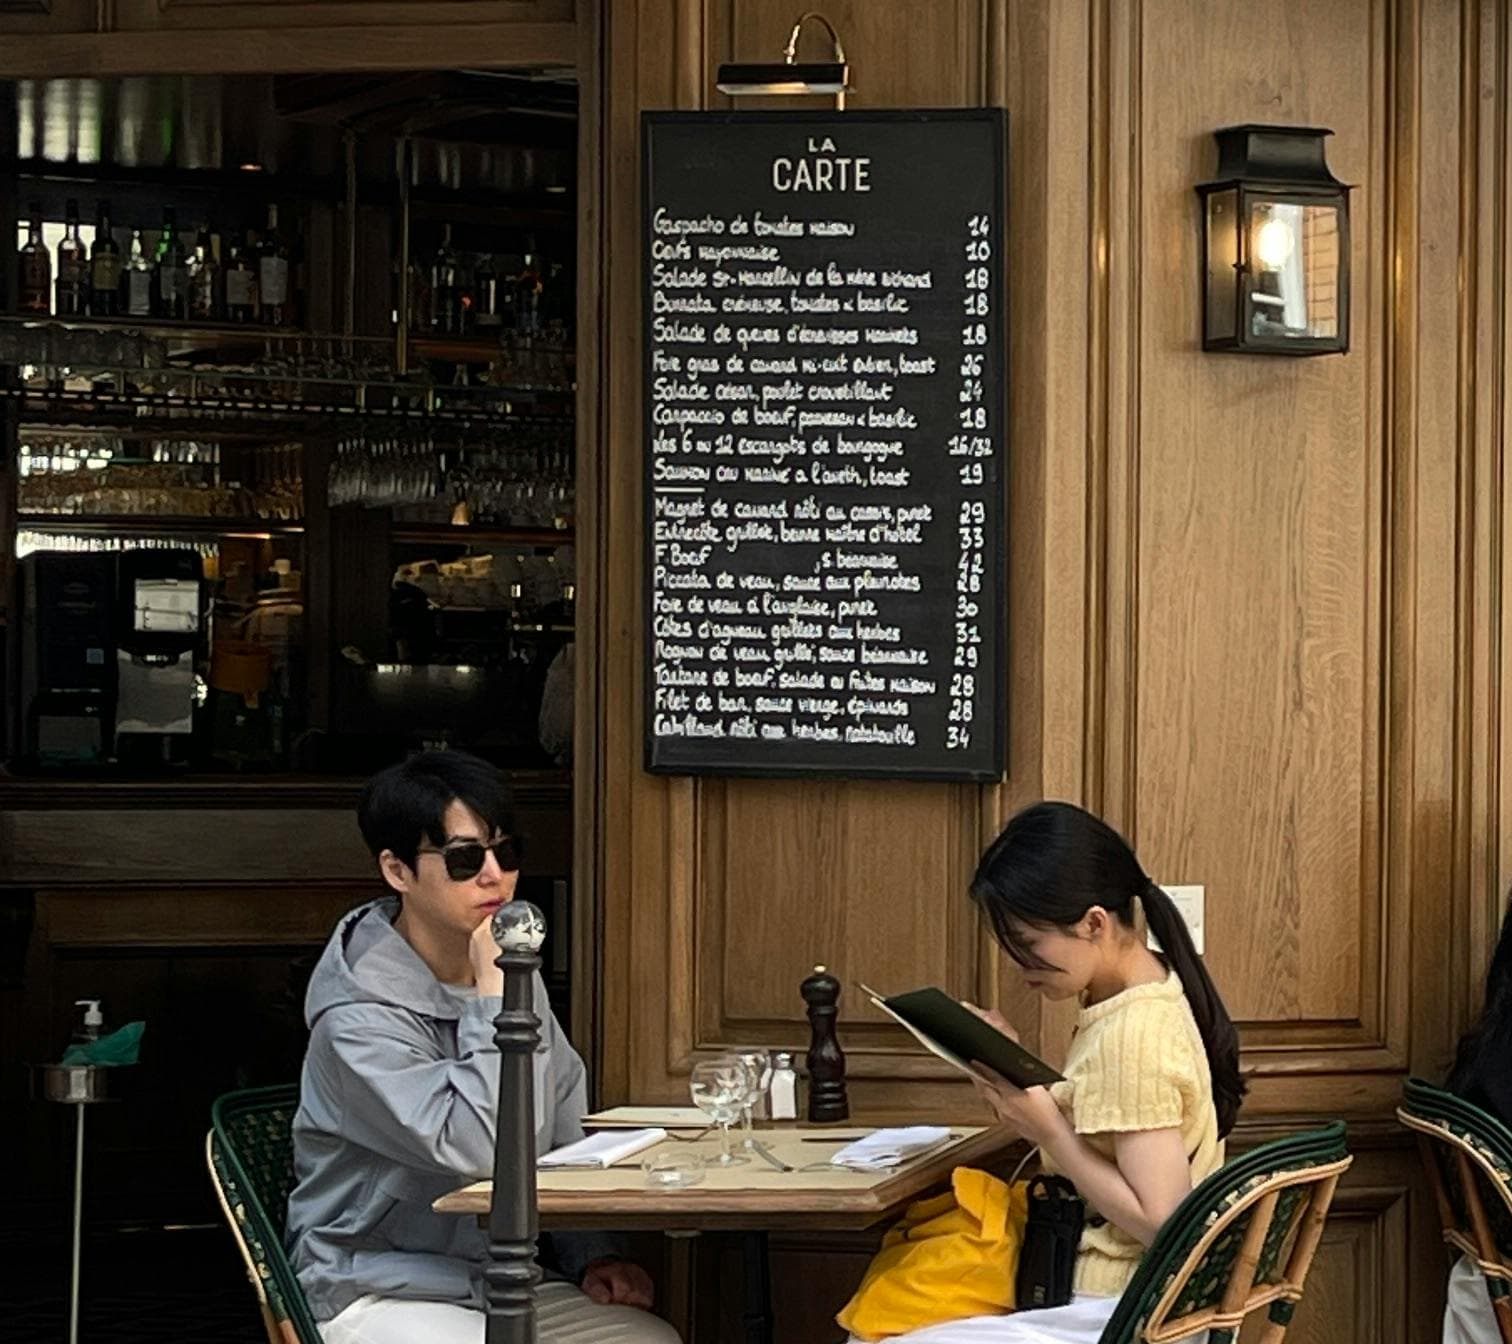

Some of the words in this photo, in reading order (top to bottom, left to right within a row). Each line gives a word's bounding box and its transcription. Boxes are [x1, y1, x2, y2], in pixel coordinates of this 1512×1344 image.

[808, 137, 837, 153] LA
[772, 158, 871, 192] CARTE
[653, 207, 725, 240] Gaspacho
[729, 214, 749, 234] de
[967, 215, 990, 237] 14
[965, 240, 992, 261] 10
[652, 263, 708, 287] Salade
[806, 267, 824, 287] de
[827, 261, 845, 286] la
[964, 266, 990, 290] 18
[963, 292, 990, 316] 18
[653, 317, 706, 343] Salade
[713, 323, 732, 344] de
[962, 322, 988, 346] 18
[687, 356, 721, 381] gras
[726, 353, 745, 373] de
[960, 353, 985, 377] 26
[653, 376, 709, 402] Salade
[960, 378, 984, 402] 24
[731, 407, 749, 426] de
[959, 407, 987, 430] 18
[682, 428, 693, 453] 6
[715, 433, 735, 455] 12
[738, 434, 807, 464] escargots
[812, 435, 831, 455] de
[947, 435, 993, 457] 16/32
[869, 466, 911, 486] toast
[960, 462, 984, 485] 19
[711, 499, 729, 519] de
[959, 501, 986, 525] 29
[959, 526, 985, 550] 33
[958, 551, 984, 574] 42
[716, 571, 736, 590] de
[956, 572, 981, 594] 28
[688, 595, 705, 614] de
[955, 594, 979, 619] 30
[954, 621, 983, 644] 31
[709, 643, 729, 662] de
[954, 645, 979, 668] 29
[712, 667, 730, 687] de
[950, 672, 975, 697] 28
[695, 690, 713, 713] de
[948, 697, 973, 723] 28
[946, 726, 971, 749] 34
